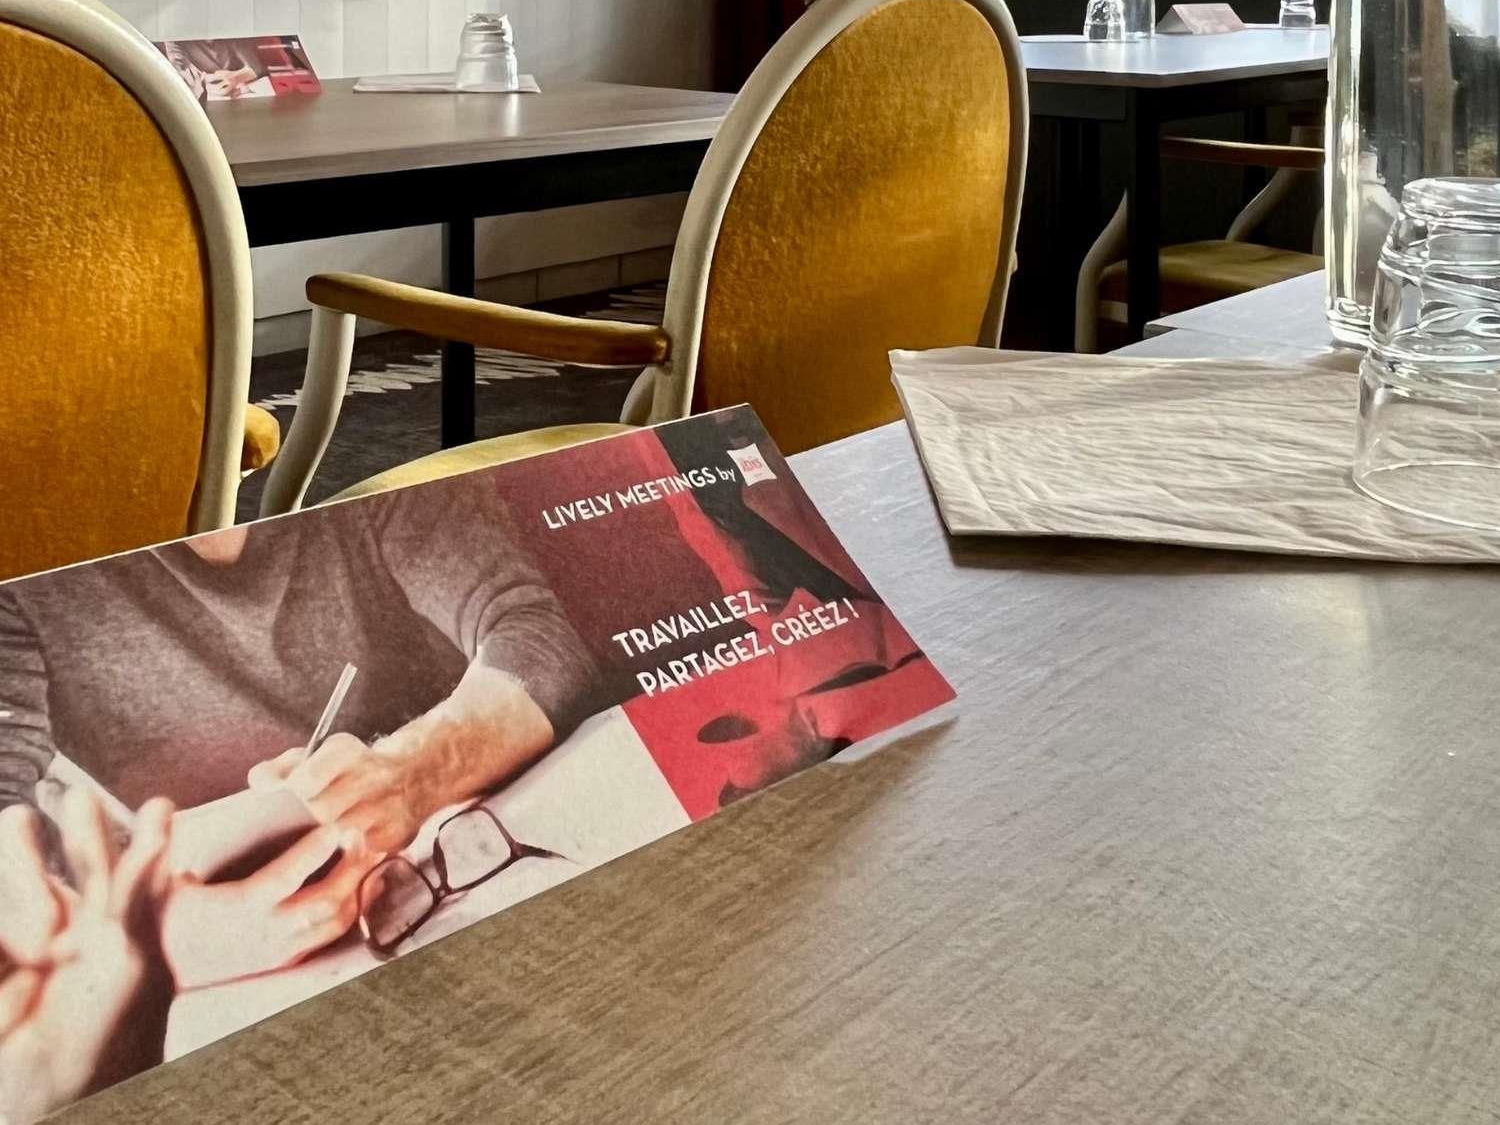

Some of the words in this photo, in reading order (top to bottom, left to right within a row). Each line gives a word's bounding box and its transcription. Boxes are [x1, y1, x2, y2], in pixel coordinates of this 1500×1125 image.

[542, 493, 613, 530] LIVELY
[615, 466, 717, 509] MEETINGS
[718, 466, 736, 482] by
[612, 590, 768, 658] TRAVAILLEZ,
[636, 631, 776, 698] PARTAGEZ,
